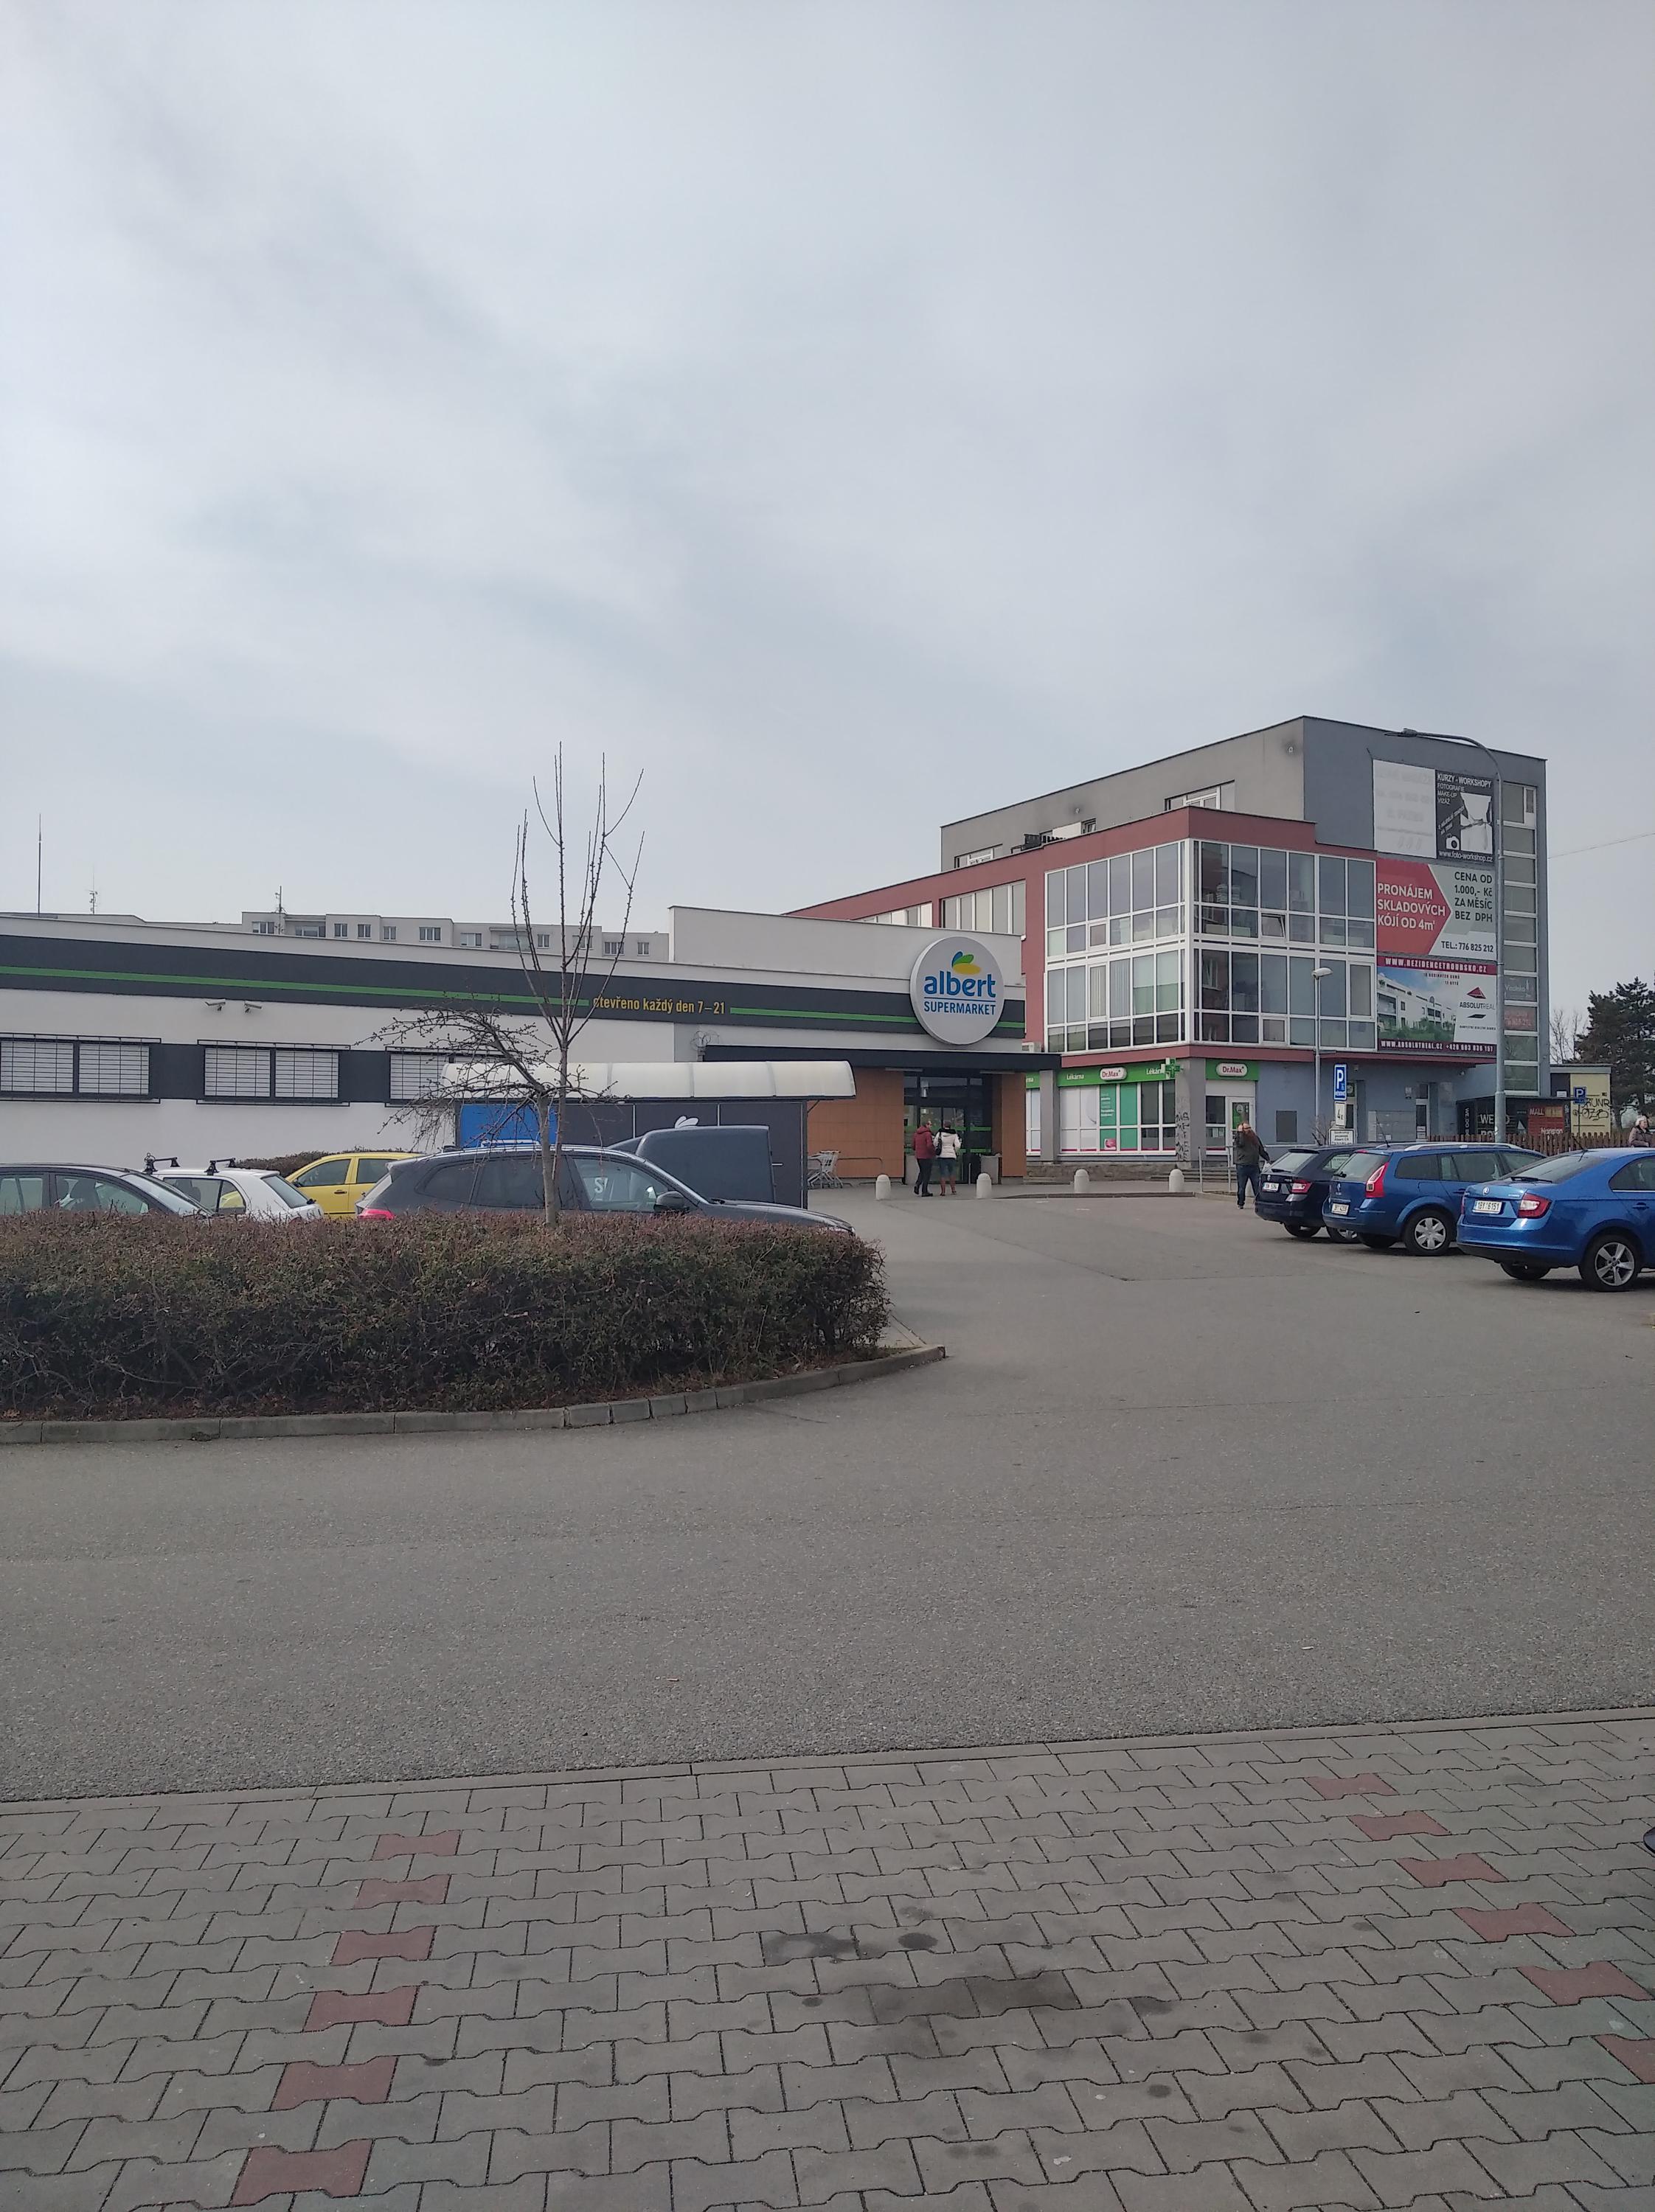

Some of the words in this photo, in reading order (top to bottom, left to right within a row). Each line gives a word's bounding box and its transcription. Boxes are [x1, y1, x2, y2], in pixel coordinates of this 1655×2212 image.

[1437, 773, 1455, 782] KURZY
[1458, 776, 1492, 787] WORKSHOPY
[1437, 783, 1465, 792] FOTOGRAFIE
[1437, 790, 1457, 798] MAKE-UP
[1438, 851, 1493, 863] www.foto-workshop.cz
[1454, 872, 1477, 883] CENA
[1480, 874, 1493, 883] OD
[1378, 883, 1432, 900] PRONÁJEM
[1454, 885, 1480, 897] 1.000,-
[1483, 887, 1492, 897] Kč
[1378, 899, 1446, 917] SKLADOVÝCH
[1454, 897, 1465, 907] ZA
[1468, 897, 1493, 909] MĚSÍC
[1378, 913, 1399, 927] KÓJÍ
[1401, 917, 1416, 929] OD
[1455, 911, 1471, 920] BEZ
[1475, 913, 1493, 922] DPH
[1441, 941, 1457, 950] TEL.:
[1458, 942, 1469, 950] 776
[1471, 943, 1482, 951] 825
[1385, 958, 1487, 973] WWW.REZIDENCETROUBSKO.CZ
[924, 970, 996, 998] albert
[593, 995, 639, 1010] otevřeno
[643, 998, 673, 1014] každý
[676, 1001, 694, 1013] den
[924, 1001, 996, 1015] SUPERMARKET
[1460, 1001, 1496, 1010] ABSOLUTREAL
[1381, 1040, 1443, 1050] WWW.ABSOLUTREAL.CZ
[1336, 1069, 1343, 1089] P
[1576, 1088, 1583, 1099] P
